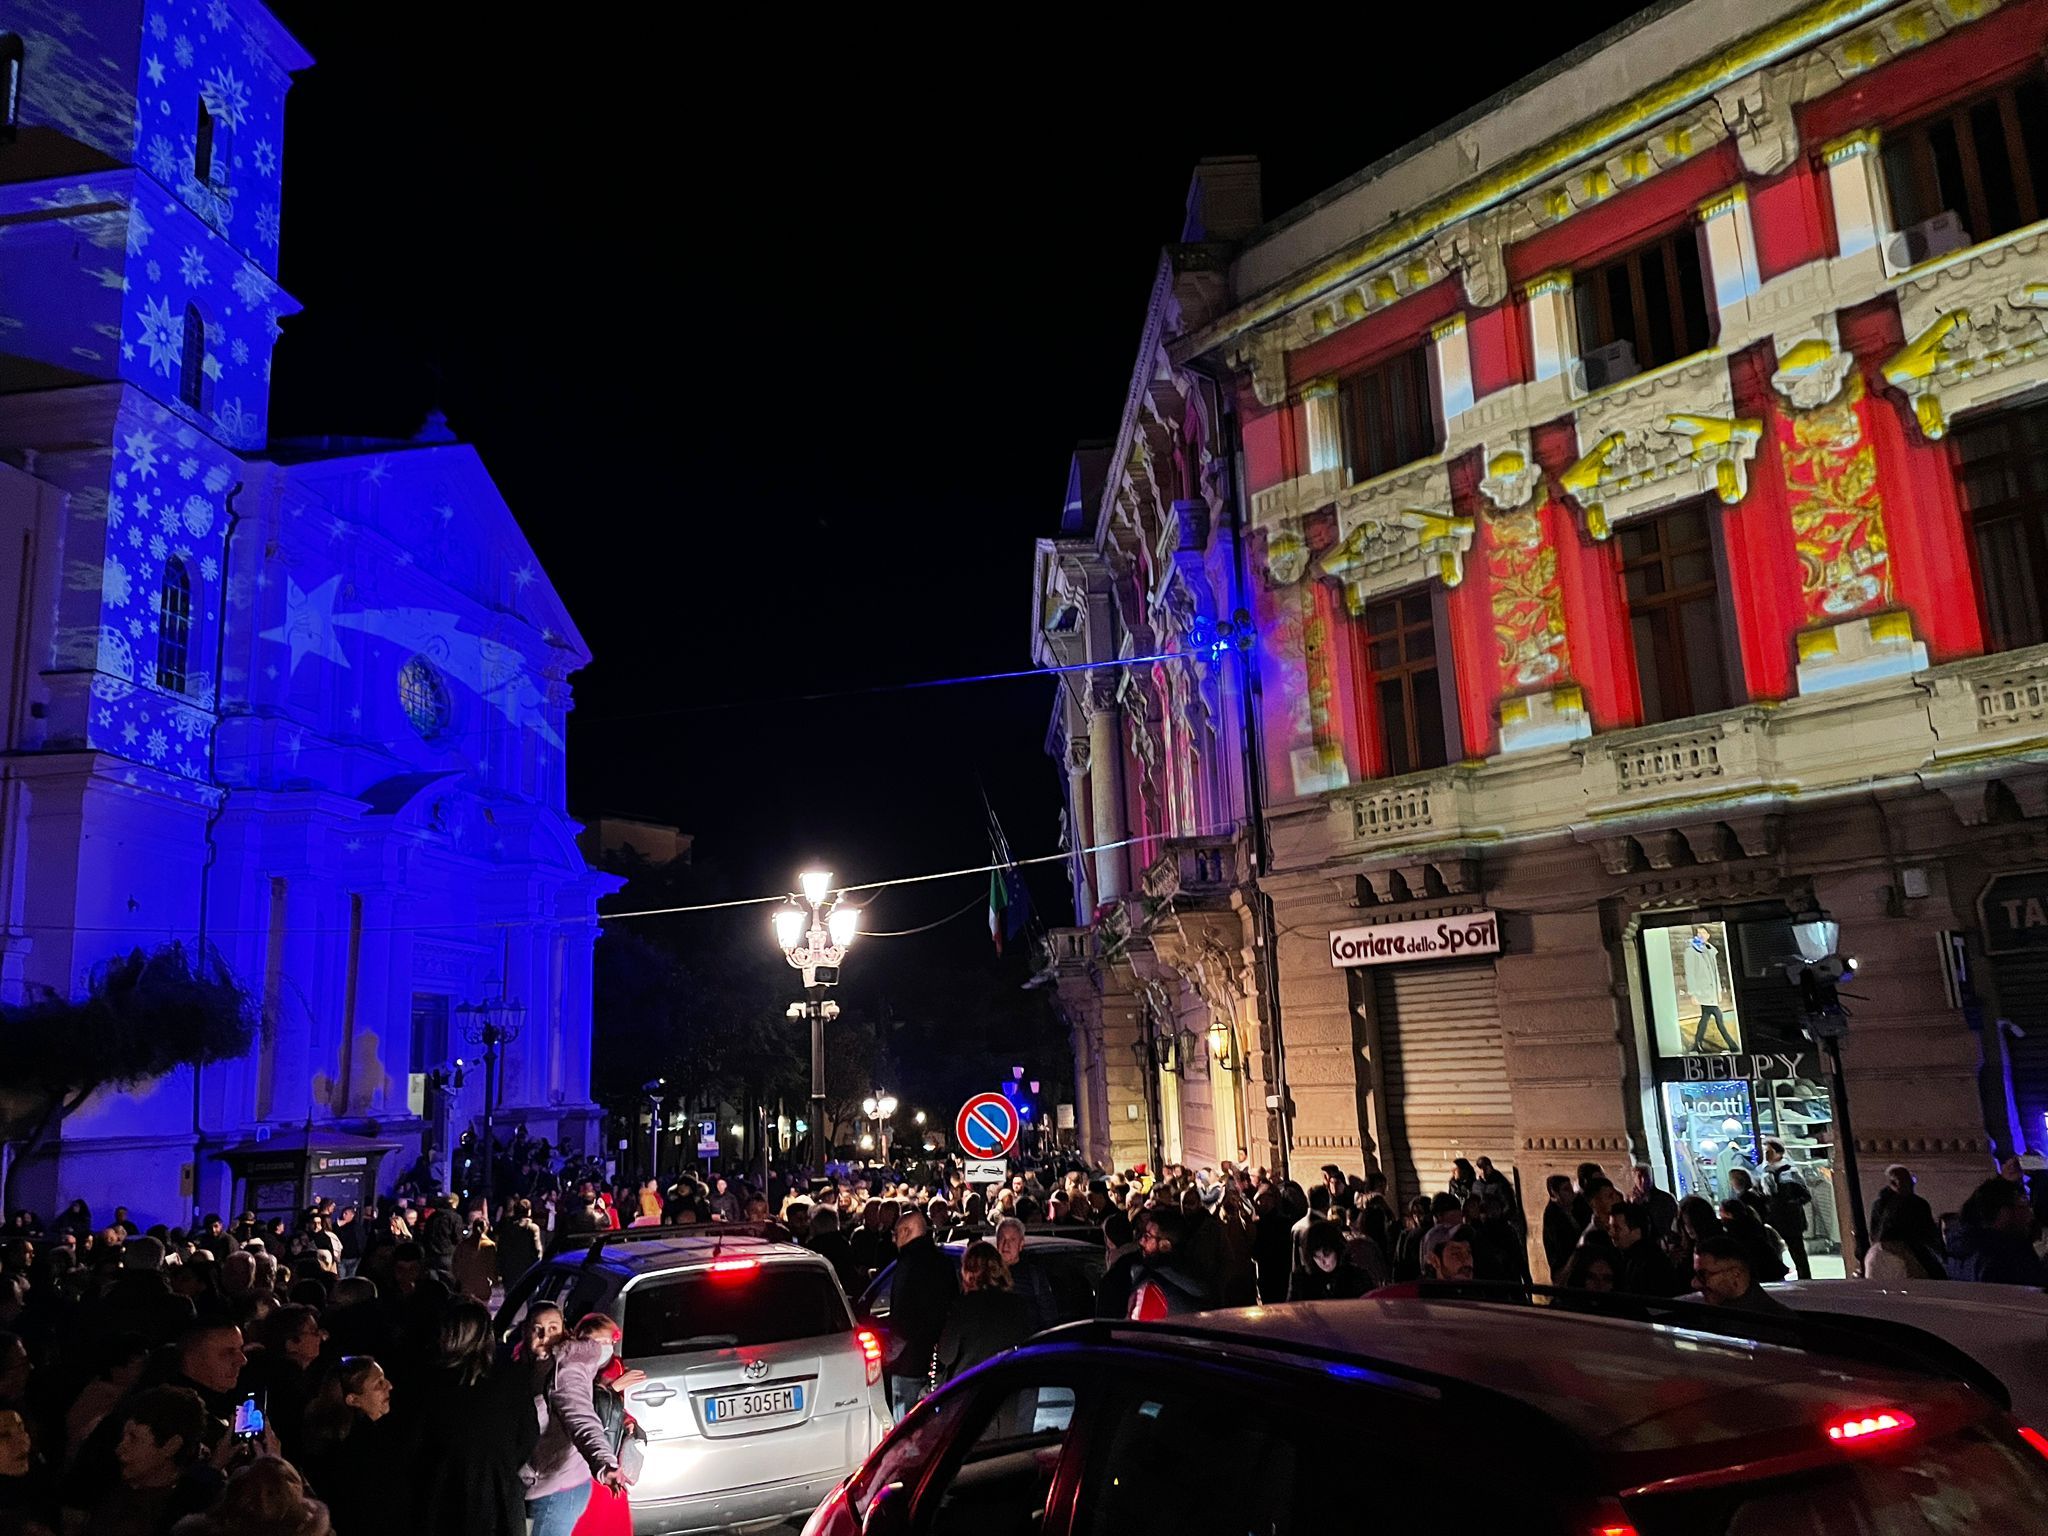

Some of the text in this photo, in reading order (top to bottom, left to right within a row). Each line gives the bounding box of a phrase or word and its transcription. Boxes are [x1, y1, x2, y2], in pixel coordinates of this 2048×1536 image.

[1332, 918, 1497, 960] Corriere dello Sport
[1682, 1052, 1805, 1081] BELPY
[703, 1122, 713, 1135] P
[718, 1390, 793, 1418] DT 305FM
